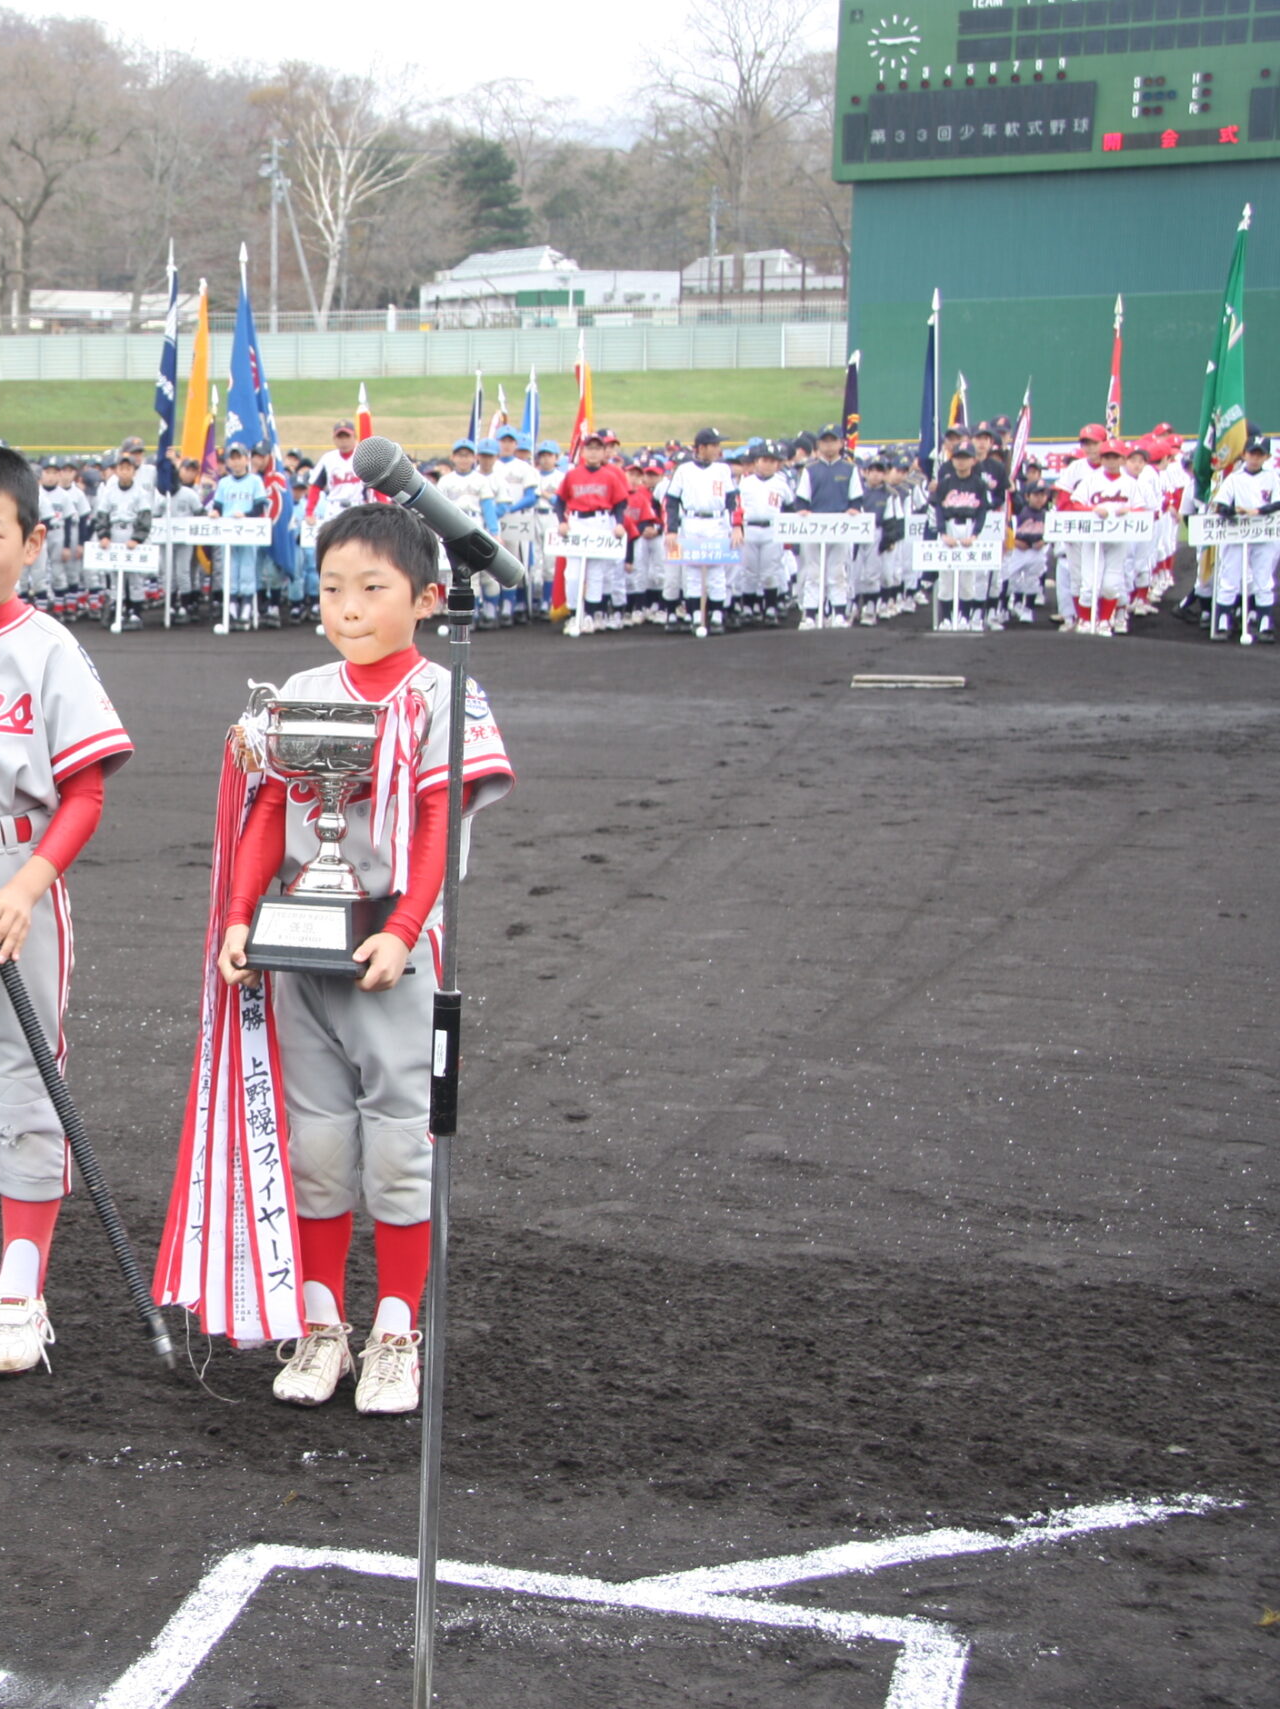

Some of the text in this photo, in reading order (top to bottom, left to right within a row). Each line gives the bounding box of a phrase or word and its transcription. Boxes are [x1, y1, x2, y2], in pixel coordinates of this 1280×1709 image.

[778, 522, 870, 535] エルムファイターズ
[1049, 519, 1149, 534] 上手稲コンドル
[923, 551, 992, 561] 白石区支部
[244, 1057, 294, 1293] 上野幌ファイヤーズ
